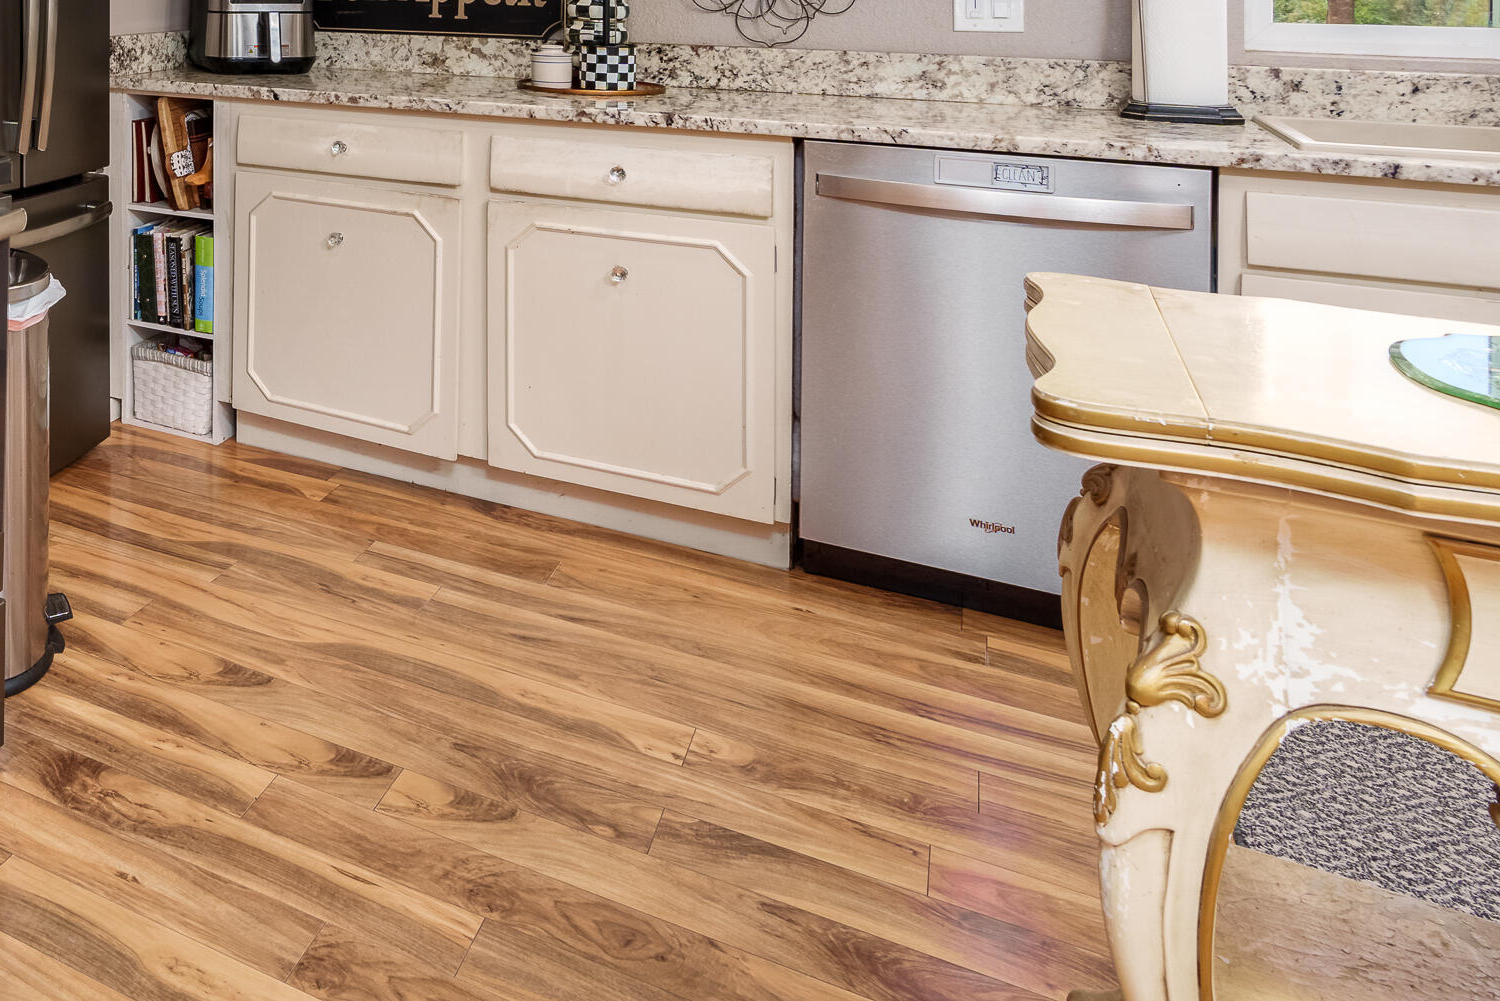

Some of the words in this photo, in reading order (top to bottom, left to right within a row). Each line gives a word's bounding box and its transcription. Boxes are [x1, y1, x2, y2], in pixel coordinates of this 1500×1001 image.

[1001, 167, 1036, 183] CLEAN
[169, 242, 177, 277] SEASONED
[969, 518, 1015, 534] Whirlpool
